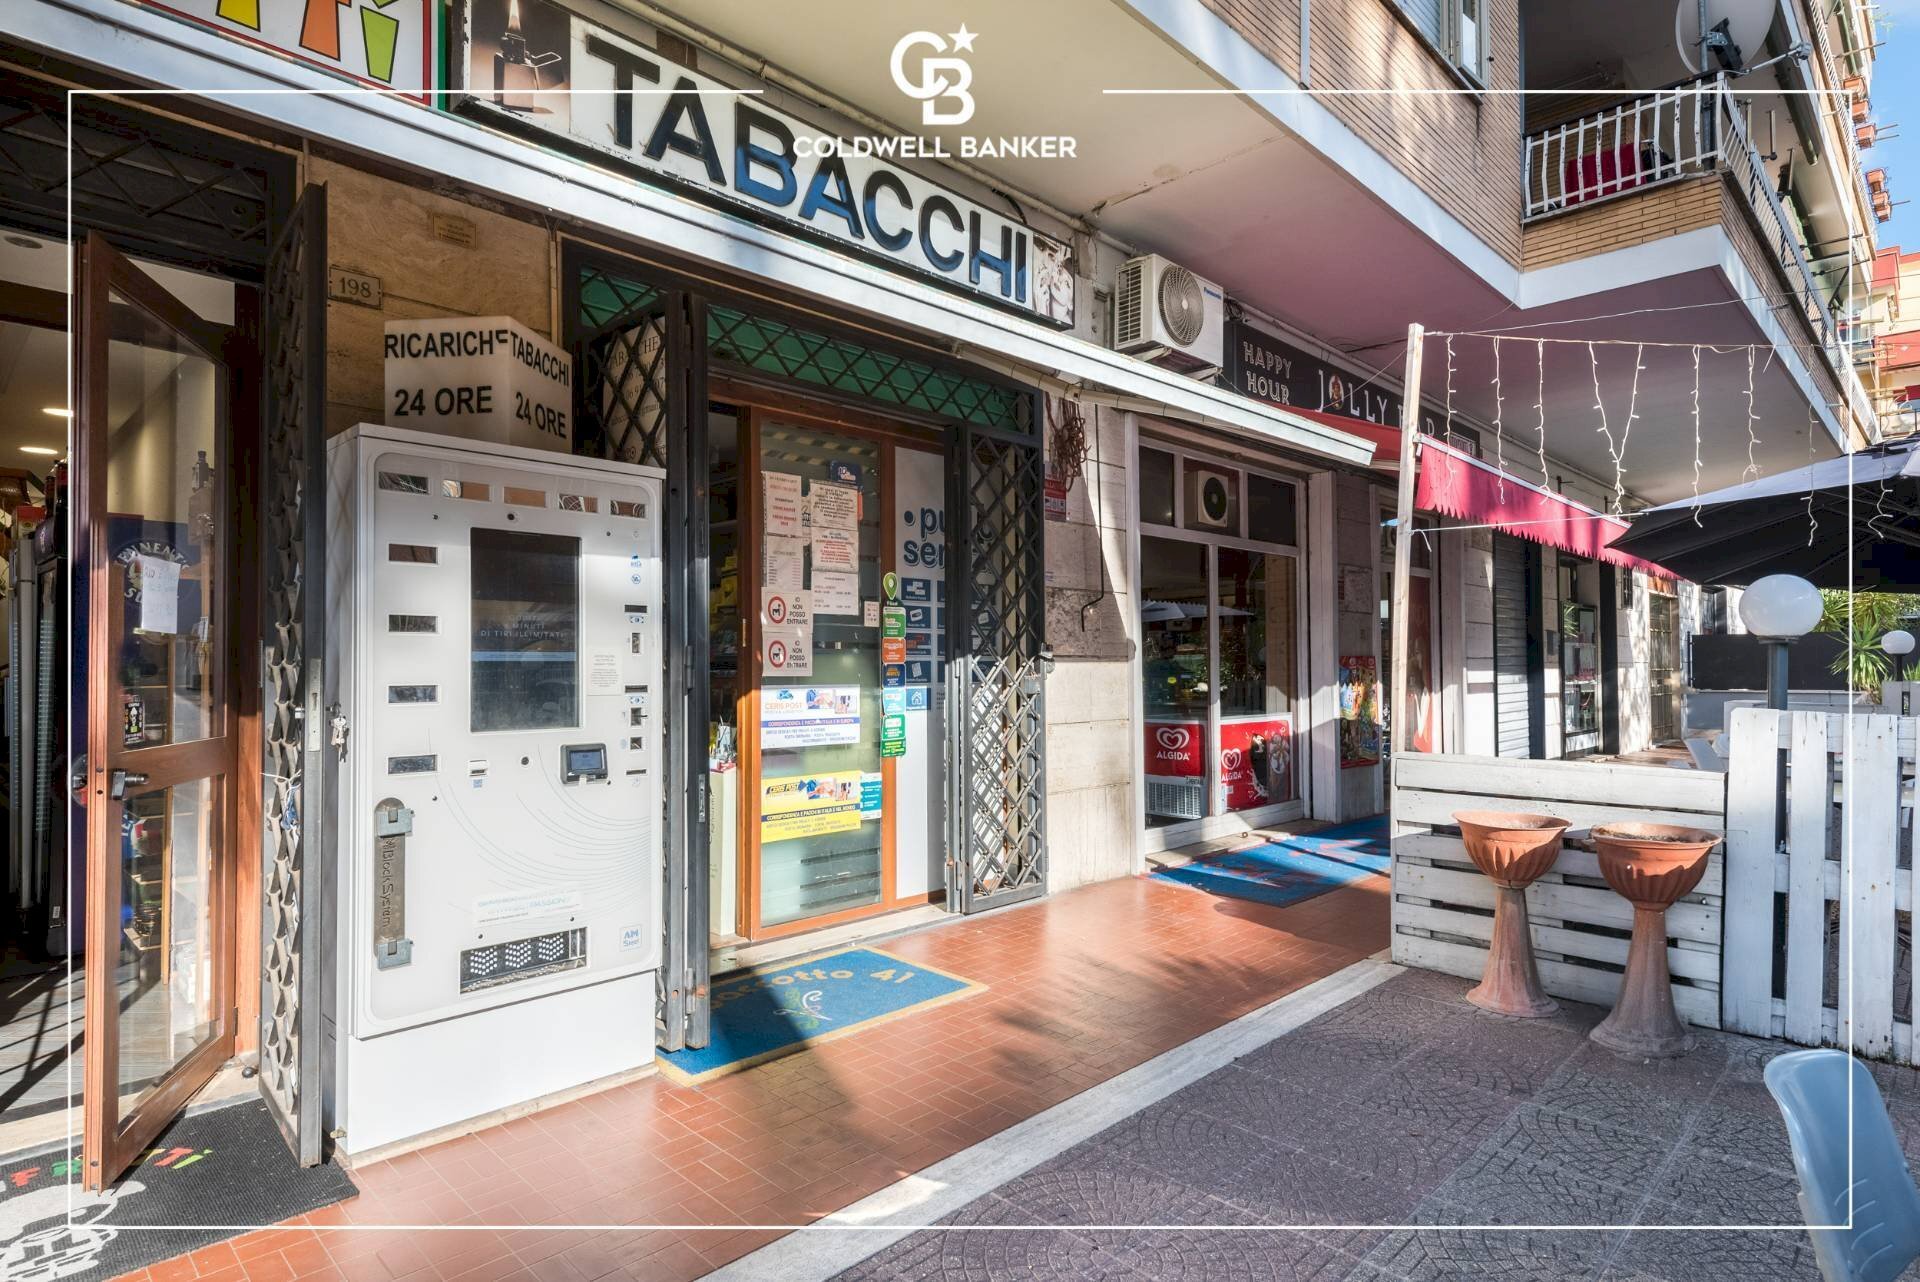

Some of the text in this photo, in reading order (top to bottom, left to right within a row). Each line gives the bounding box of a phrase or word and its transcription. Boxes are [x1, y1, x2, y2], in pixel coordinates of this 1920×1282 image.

[585, 34, 1028, 304] TABACCHI
[339, 277, 371, 298] 198
[510, 331, 570, 387] TABACCHI
[1243, 341, 1292, 379] HAPPY
[394, 385, 493, 416] 24 ORE
[1246, 370, 1289, 406] HOUR
[515, 391, 567, 439] 24 ORE
[1156, 751, 1190, 761] ALGIDA
[1221, 772, 1242, 782] ALGIDA
